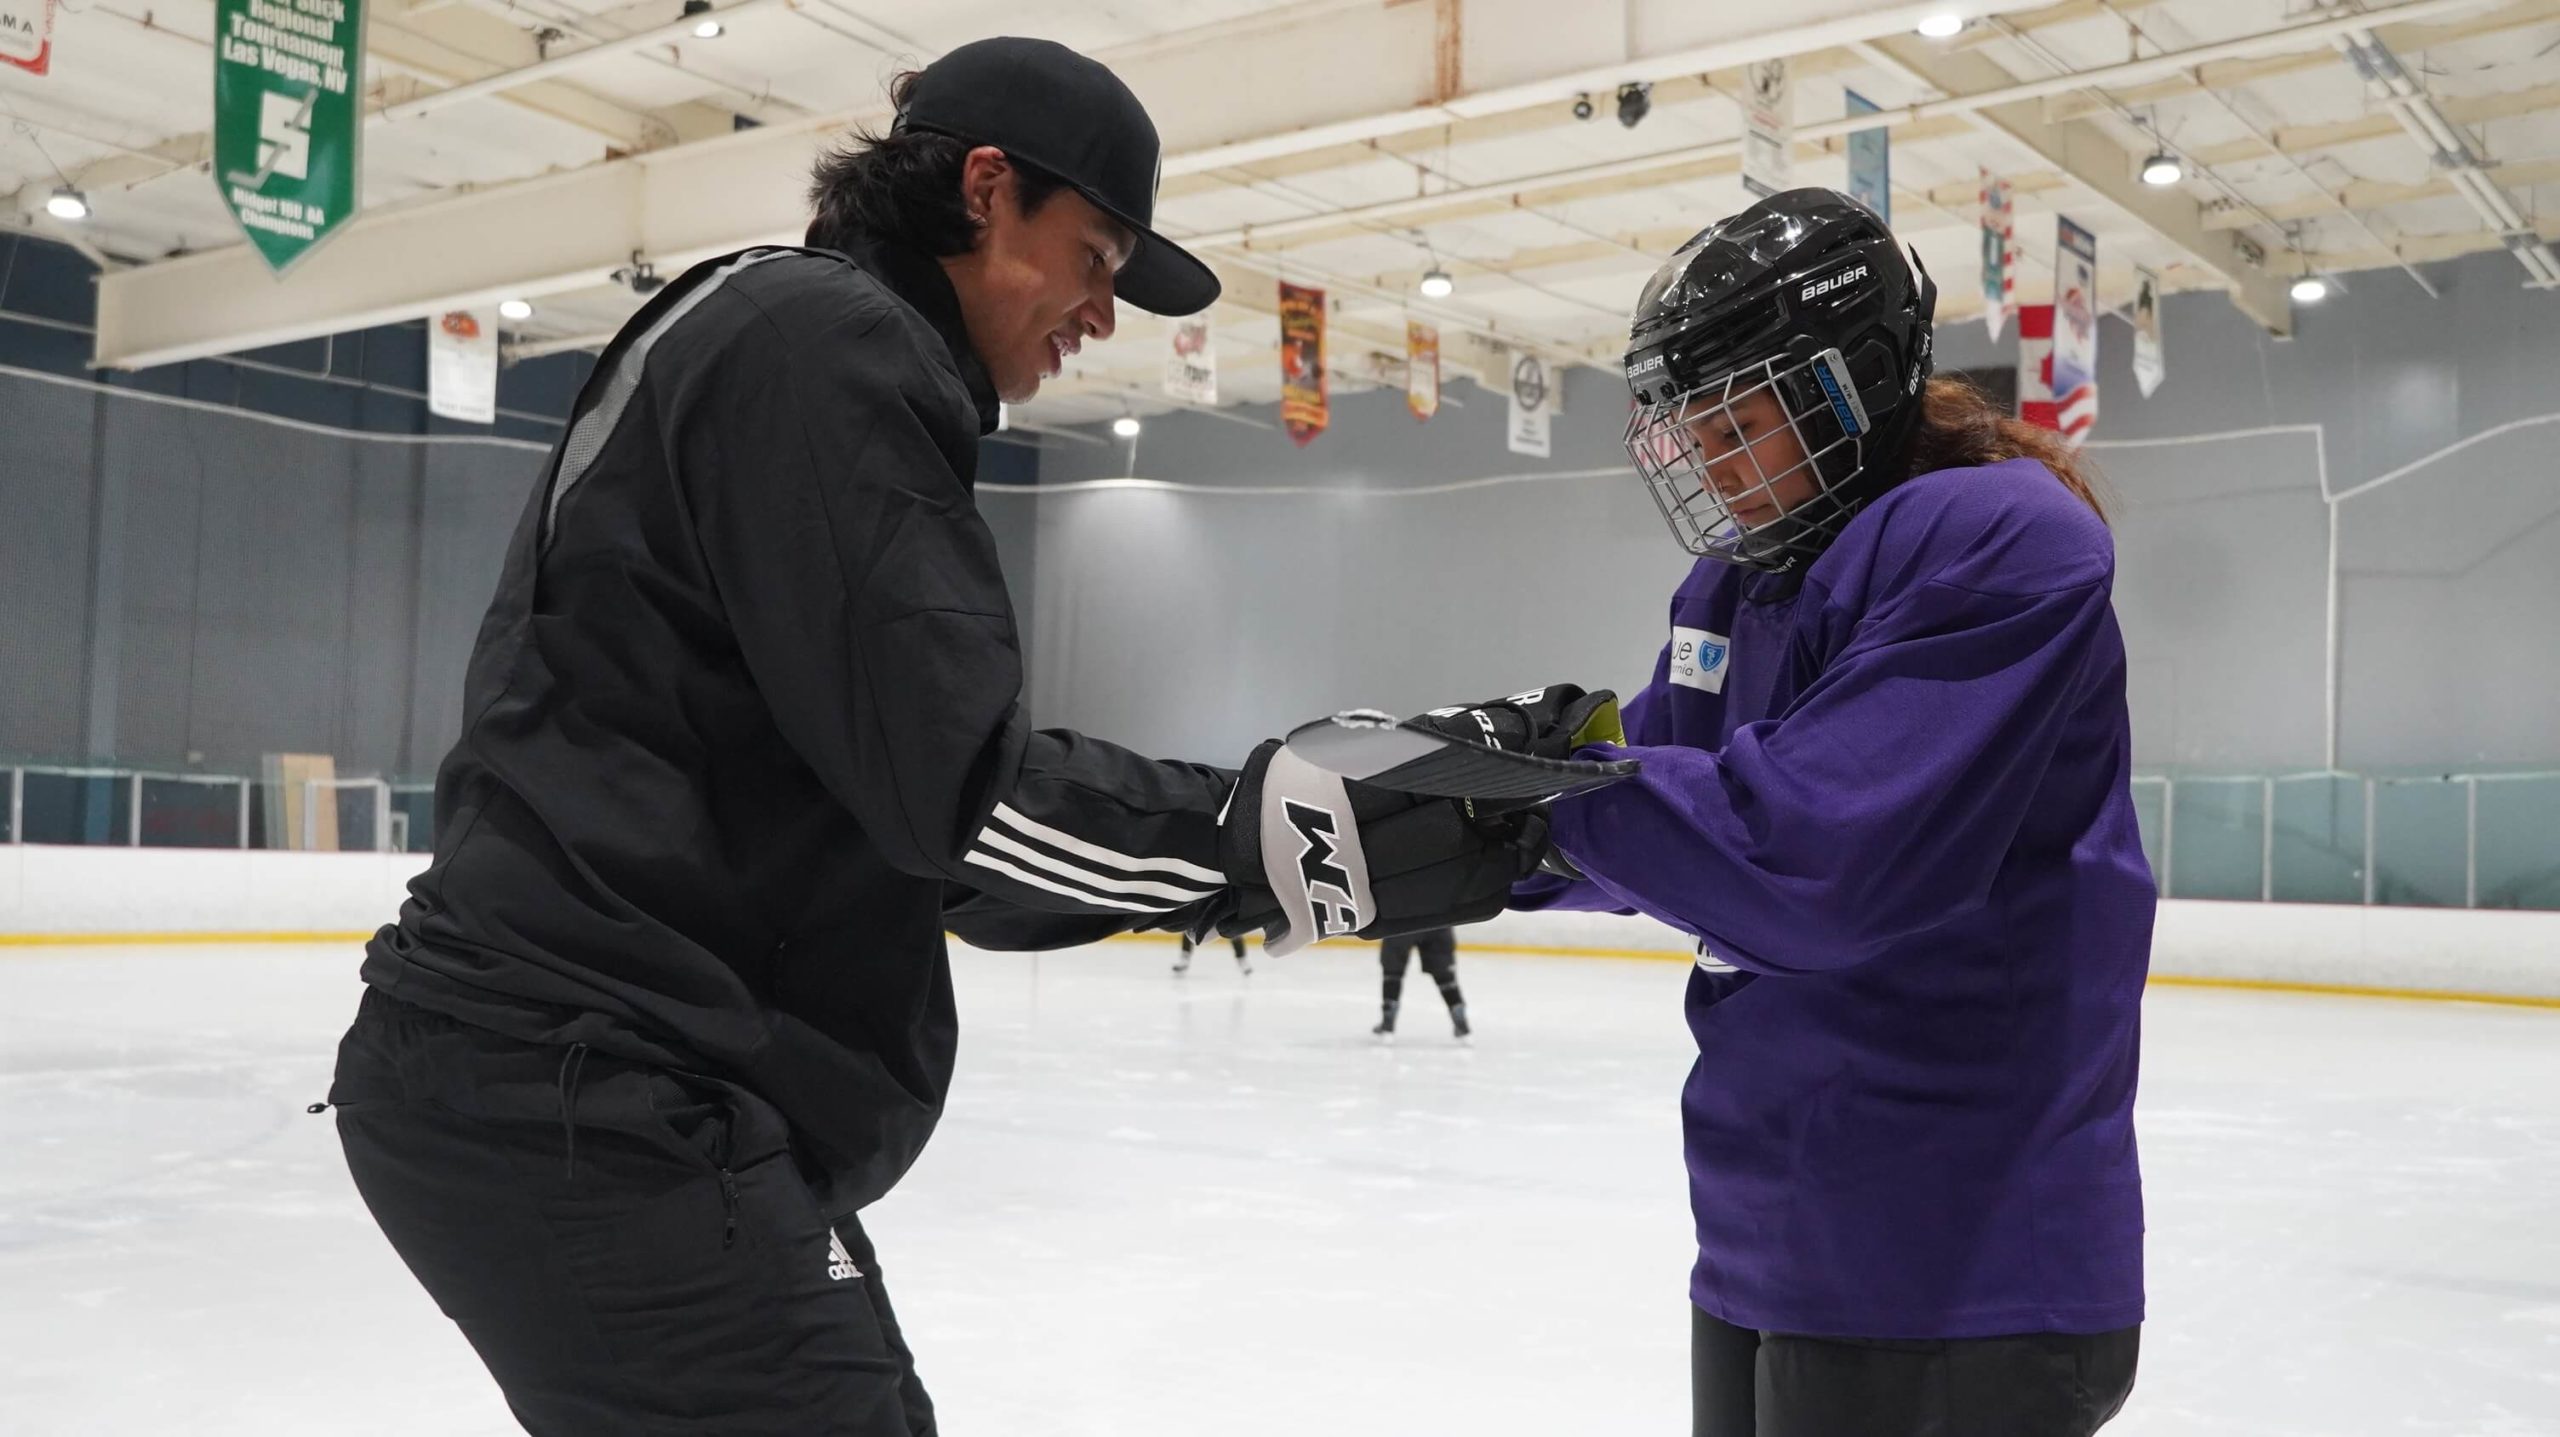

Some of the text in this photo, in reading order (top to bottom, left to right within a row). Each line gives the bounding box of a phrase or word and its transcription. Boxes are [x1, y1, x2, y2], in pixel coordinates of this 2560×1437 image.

[0, 13, 34, 36] MA
[230, 11, 345, 69] Tournament
[250, 0, 335, 42] Regional
[222, 35, 348, 94] Las Vegas, NV
[232, 186, 278, 214] Midget
[241, 207, 315, 241] Champions
[1800, 264, 1869, 302] BAUER
[1626, 354, 1665, 379] BAUER
[1817, 365, 1858, 434] BAUER
